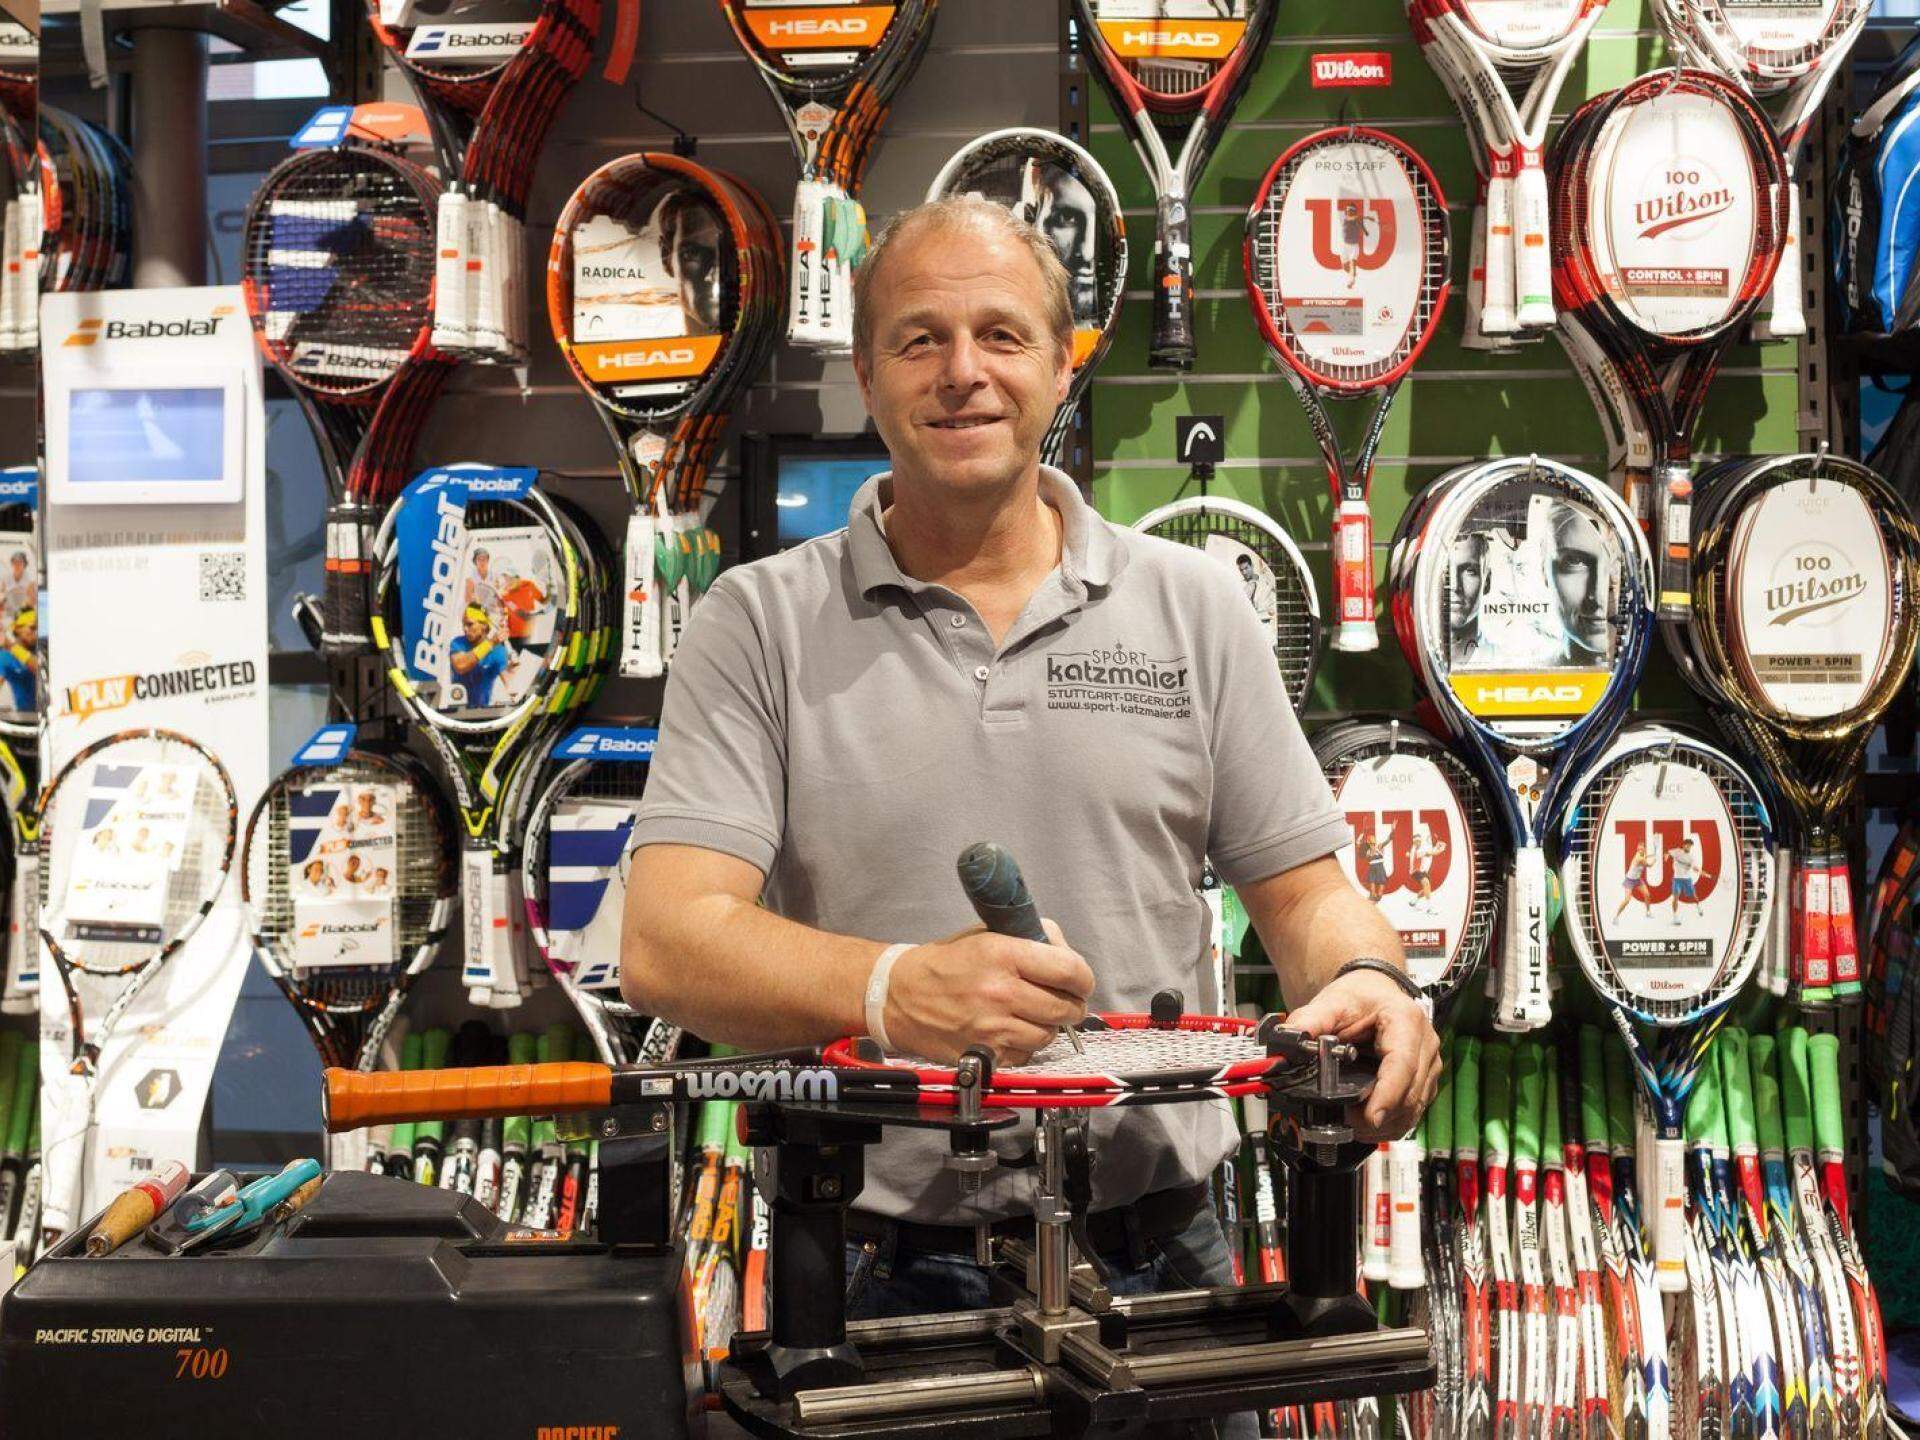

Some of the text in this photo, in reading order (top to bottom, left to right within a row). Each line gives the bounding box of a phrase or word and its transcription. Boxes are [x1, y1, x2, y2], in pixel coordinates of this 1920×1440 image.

[769, 18, 868, 35] HEAD
[1123, 31, 1220, 47] HEAD
[1315, 60, 1385, 81] Wilson
[1315, 161, 1387, 172] PRO STAFF
[1665, 171, 1700, 185] 100
[1634, 188, 1735, 225] Wilson
[582, 266, 646, 279] RADICAL
[1627, 269, 1684, 281] CONTROL
[1695, 269, 1723, 281] SPIN
[598, 348, 696, 369] HEAD
[1332, 346, 1365, 357] Wilson
[1795, 556, 1831, 571] 100
[1764, 572, 1867, 611] Wilson
[1483, 602, 1550, 614] INSTINCT
[1092, 648, 1147, 667] SPORT
[1769, 657, 1811, 667] POWER
[1825, 657, 1852, 667] SPIN
[1047, 657, 1187, 690] katzmaier
[77, 678, 126, 710] PLAY
[134, 660, 256, 700] CONNECTED
[1048, 688, 1191, 708] STUTTGART-DEGERLOCH
[1477, 685, 1584, 704] HEAD
[1048, 701, 1191, 720] www.sport-katzmaier.de
[1412, 930, 1440, 942] SPIN
[1621, 942, 1666, 953] POWER
[1678, 941, 1707, 952] SPIN
[1650, 980, 1684, 990] Wilson
[685, 1069, 838, 1100] Wilson
[35, 1328, 88, 1344] PACIFIC
[90, 1328, 144, 1344] STRING
[147, 1327, 201, 1343] DIGITAL
[175, 1347, 229, 1379] 700
